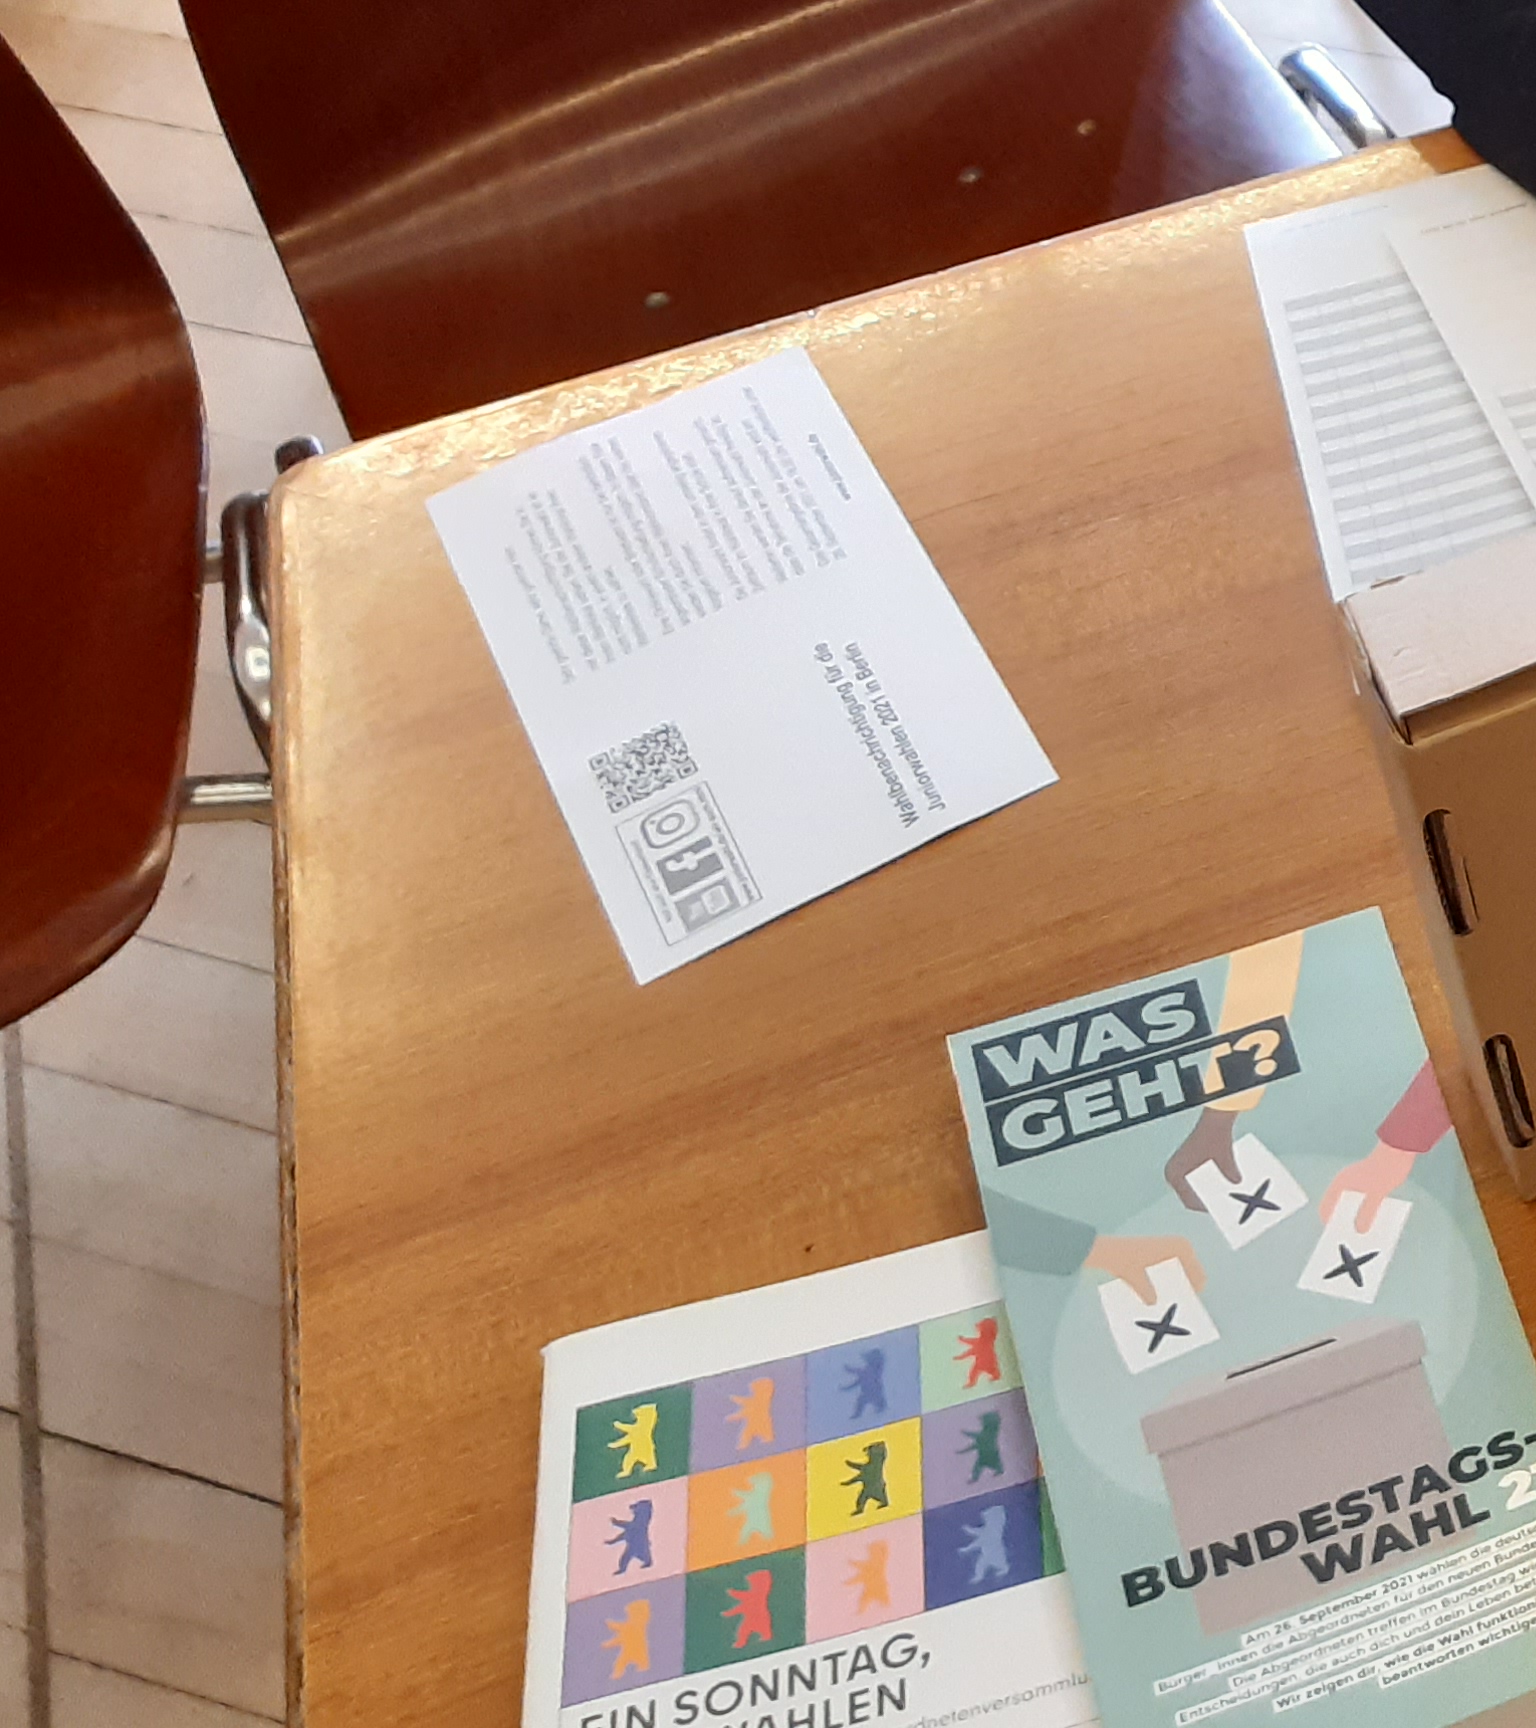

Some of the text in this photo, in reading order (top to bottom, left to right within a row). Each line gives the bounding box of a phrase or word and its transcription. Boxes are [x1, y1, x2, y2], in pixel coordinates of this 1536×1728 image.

[814, 642, 920, 828] Wahlbenachrichtigung für die
[845, 641, 946, 811] Juniorwahlen 2021 in Berlin
[982, 991, 1197, 1088] WAS
[1001, 1028, 1281, 1150] GEHT?
[1300, 1492, 1491, 1585] WAHL
[1231, 1670, 1257, 1688] Die
[1258, 1627, 1364, 1677] Abgeordneten
[1365, 1607, 1416, 1636] treffen
[1417, 1599, 1437, 1615] im
[1439, 1568, 1516, 1607] Bundestag
[1243, 1627, 1271, 1645] Am
[1297, 1584, 1379, 1624] September
[1379, 1571, 1414, 1592] 2021
[1415, 1550, 1467, 1578] wählen
[1468, 1541, 1491, 1557] die
[1259, 1636, 1285, 1654] die
[1286, 1595, 1391, 1644] Abgeordneten
[1391, 1584, 1418, 1603] für
[1418, 1574, 1444, 1593] den
[1446, 1558, 1491, 1582] neuen
[1302, 1658, 1327, 1676] die
[1328, 1643, 1365, 1666] auch
[1366, 1629, 1399, 1651] dich
[1400, 1617, 1431, 1637] und
[1431, 1604, 1465, 1625] dein
[1466, 1586, 1511, 1612] Leben
[673, 1632, 931, 1725] SONNTAG,
[1276, 1691, 1302, 1709] Wir
[1303, 1670, 1353, 1698] zeigen
[1355, 1659, 1381, 1678] dir,
[1382, 1648, 1409, 1667] wie
[1410, 1638, 1435, 1656] die
[1435, 1622, 1474, 1646] Wahl
[1380, 1640, 1474, 1685] beantworten
